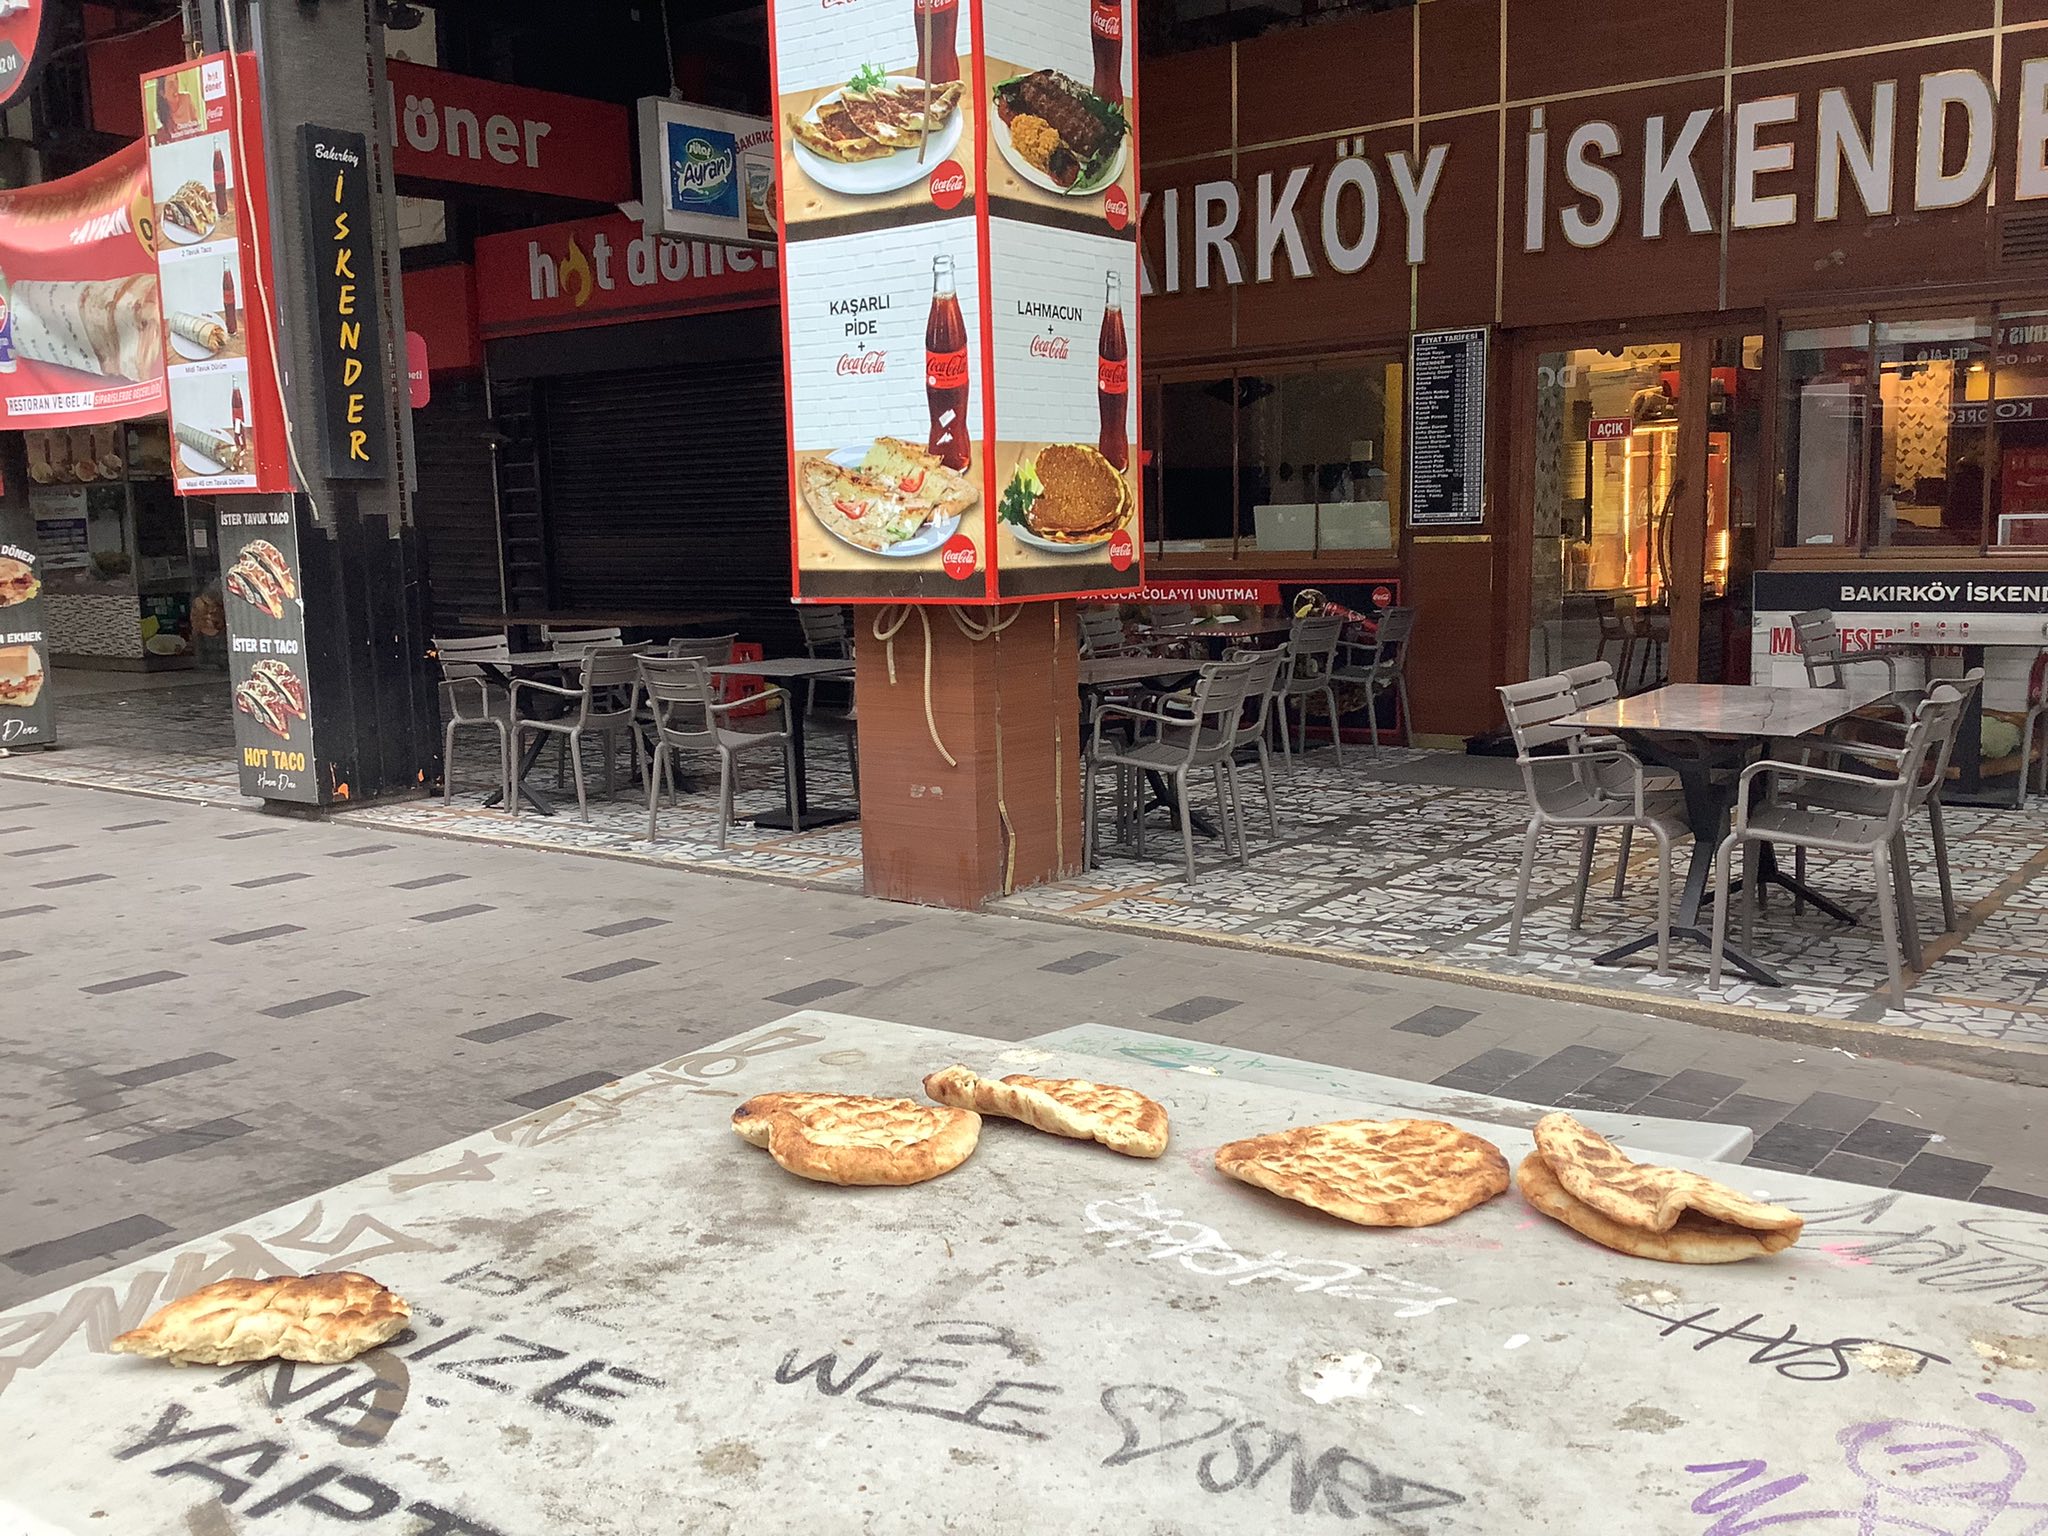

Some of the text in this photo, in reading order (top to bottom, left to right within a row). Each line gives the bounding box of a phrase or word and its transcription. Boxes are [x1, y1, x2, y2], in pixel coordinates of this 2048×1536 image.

[684, 156, 726, 187] Ayran
[931, 174, 964, 195] Coca-Cola
[1106, 198, 1127, 216] Coca-Cola
[334, 169, 370, 462] İSKENDER
[829, 295, 890, 316] KAŞARLI
[1017, 300, 1082, 321] LAHMACUN
[844, 318, 877, 337] PİDE
[1030, 335, 1070, 360] Coca-Cola
[836, 350, 888, 376] Coca-Cola
[9, 398, 49, 412] RESTORAN
[52, 397, 63, 409] VE
[66, 396, 81, 408] GEL
[83, 394, 92, 407] AL
[1597, 422, 1623, 437] AÇIK
[220, 511, 289, 526] İSTER TAVUK TACO
[1, 544, 36, 564] DÖNER
[943, 549, 975, 565] Coca-Cola
[1109, 543, 1132, 556] Coca-Cola
[1197, 588, 1259, 600] UNUTMA!
[1841, 582, 1960, 602] BAKIRKÖY
[7, 632, 42, 643] EKMEK
[232, 634, 298, 655] İSTER ET TACO
[244, 747, 305, 772] HOT TACO
